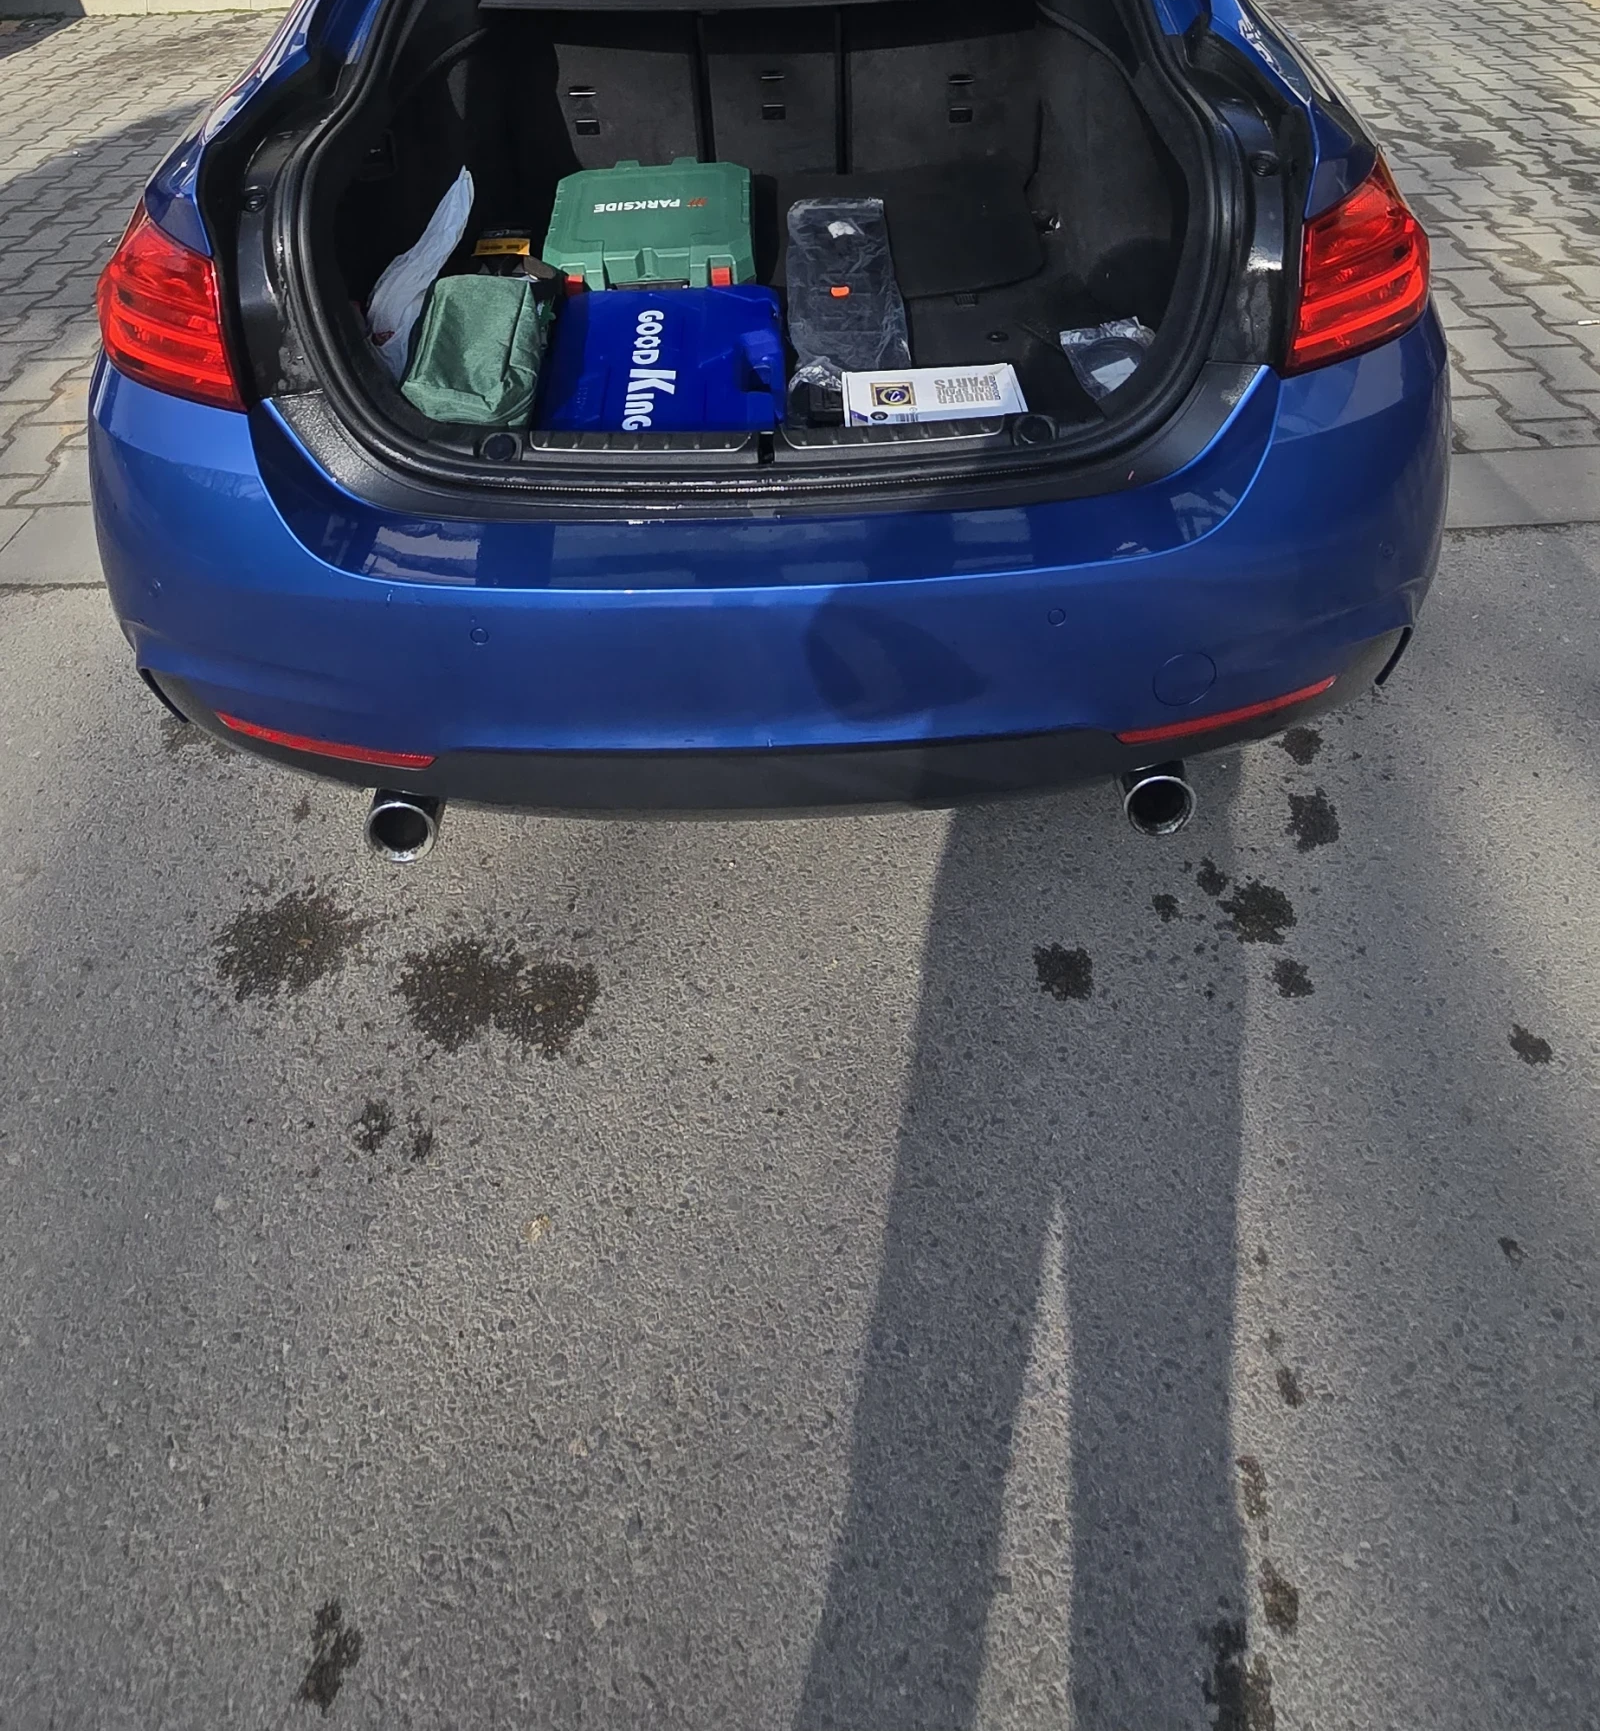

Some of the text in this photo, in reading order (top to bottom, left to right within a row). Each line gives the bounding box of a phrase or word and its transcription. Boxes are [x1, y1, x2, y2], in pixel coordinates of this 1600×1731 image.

[593, 199, 681, 214] PARKSIDE
[934, 375, 990, 390] PARTS
[937, 392, 994, 405] RUBBER
